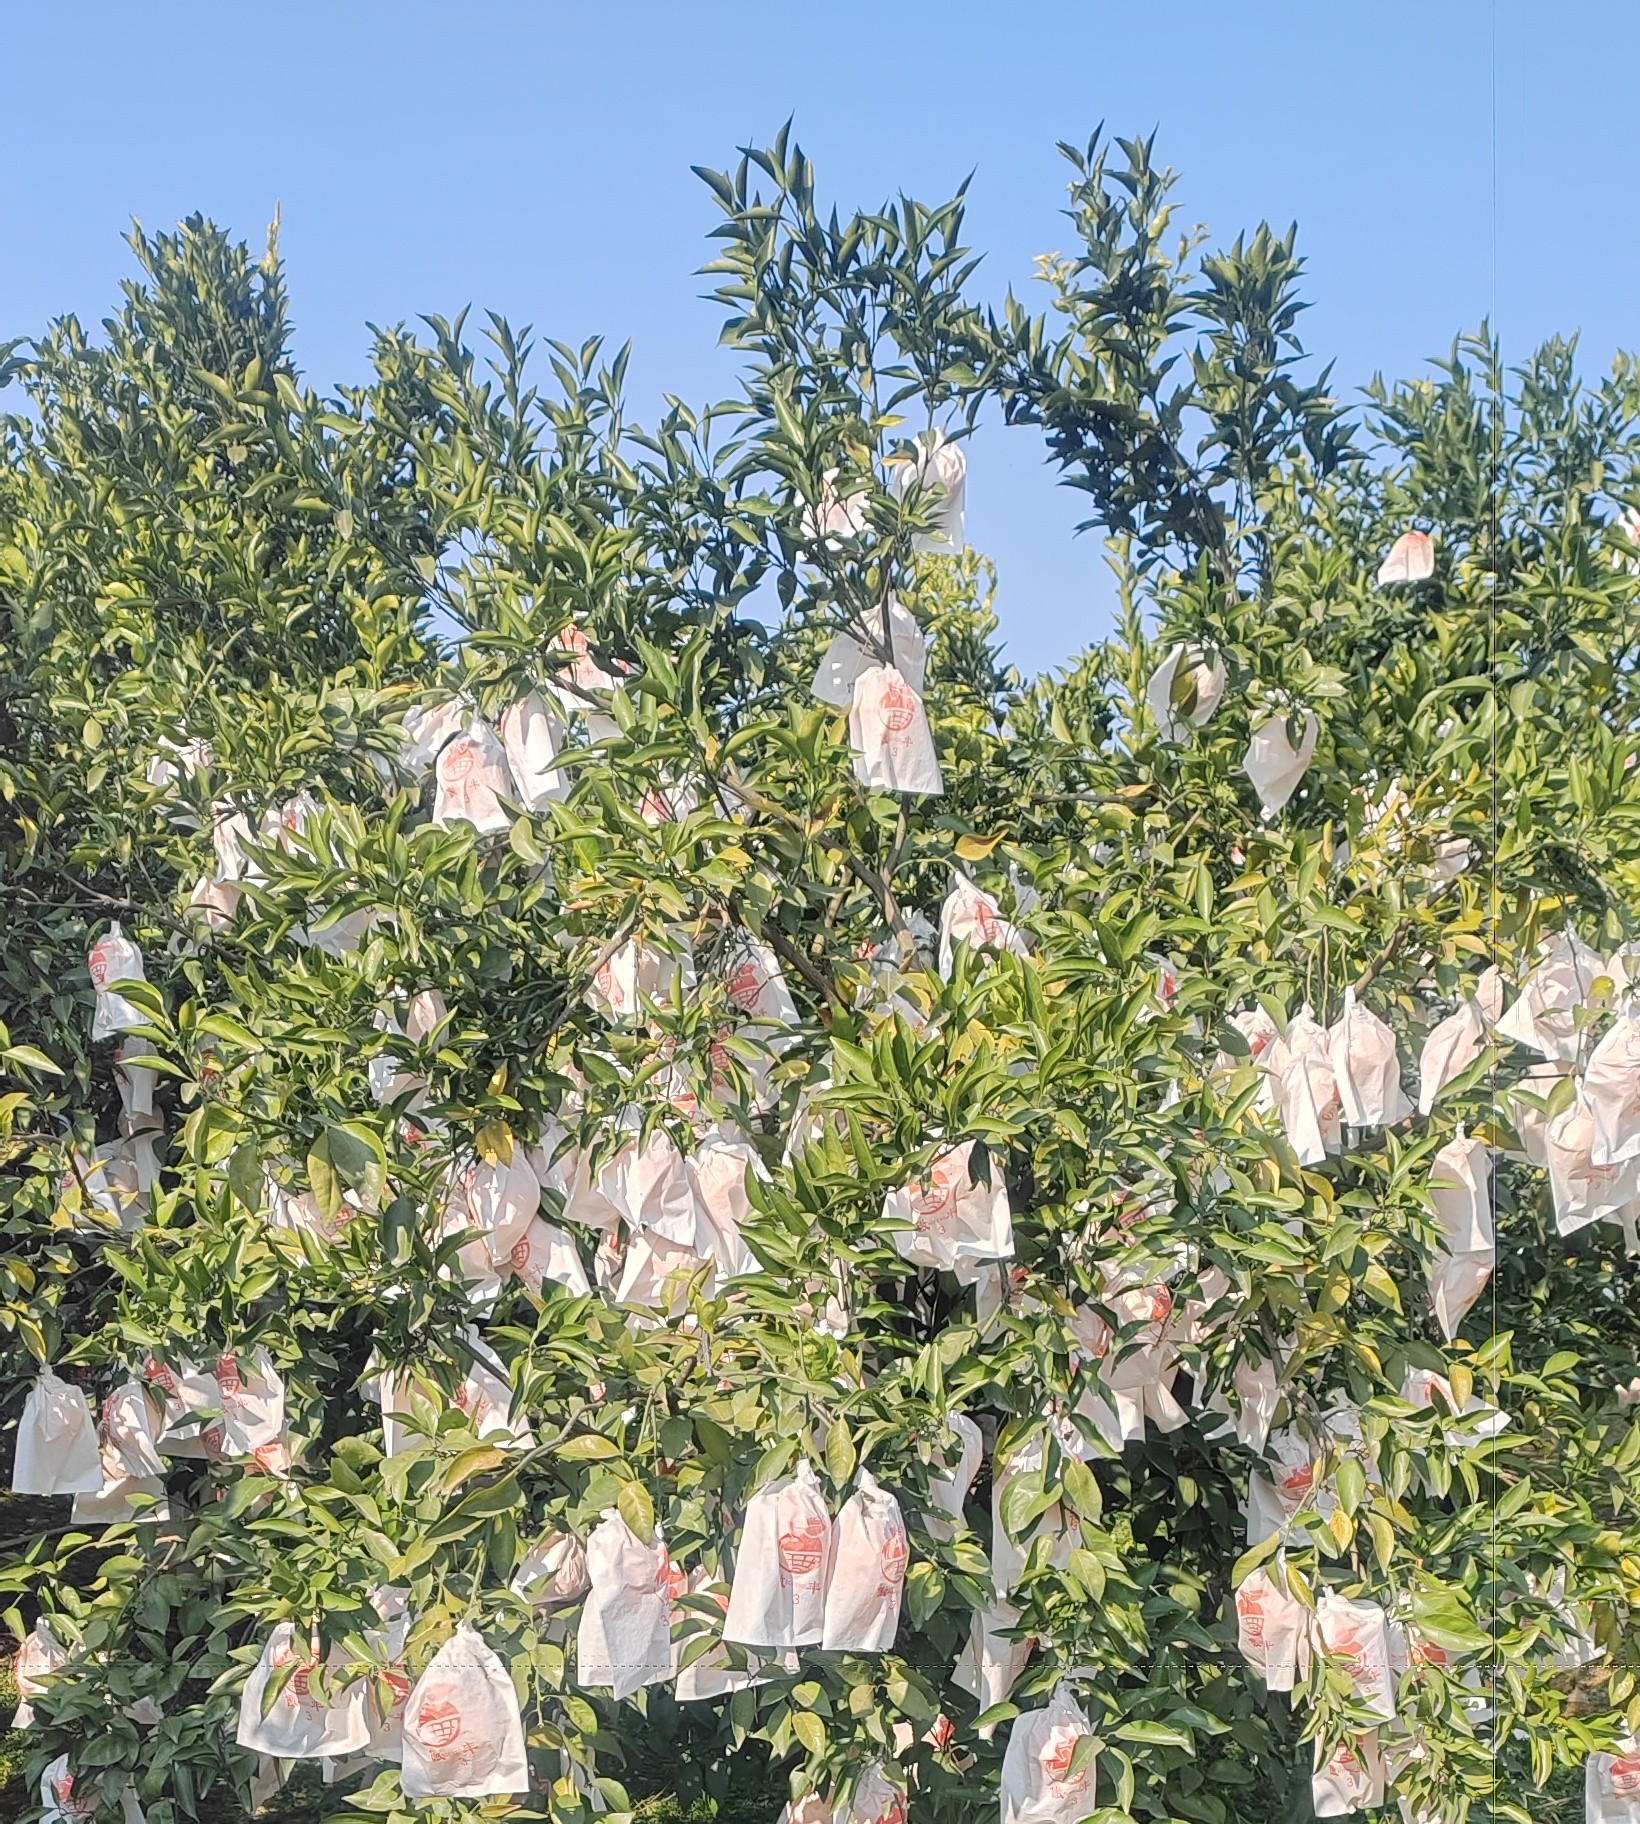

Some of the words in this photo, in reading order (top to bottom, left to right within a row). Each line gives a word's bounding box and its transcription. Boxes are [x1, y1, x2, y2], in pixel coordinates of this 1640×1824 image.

[891, 746, 898, 757] 3
[939, 1224, 946, 1235] 3
[806, 1581, 822, 1595] 丰
[793, 1594, 800, 1605] 3
[305, 1710, 313, 1721] 3
[383, 1722, 391, 1732] 3
[1346, 1777, 1354, 1788] 3
[1070, 1796, 1078, 1806] 3
